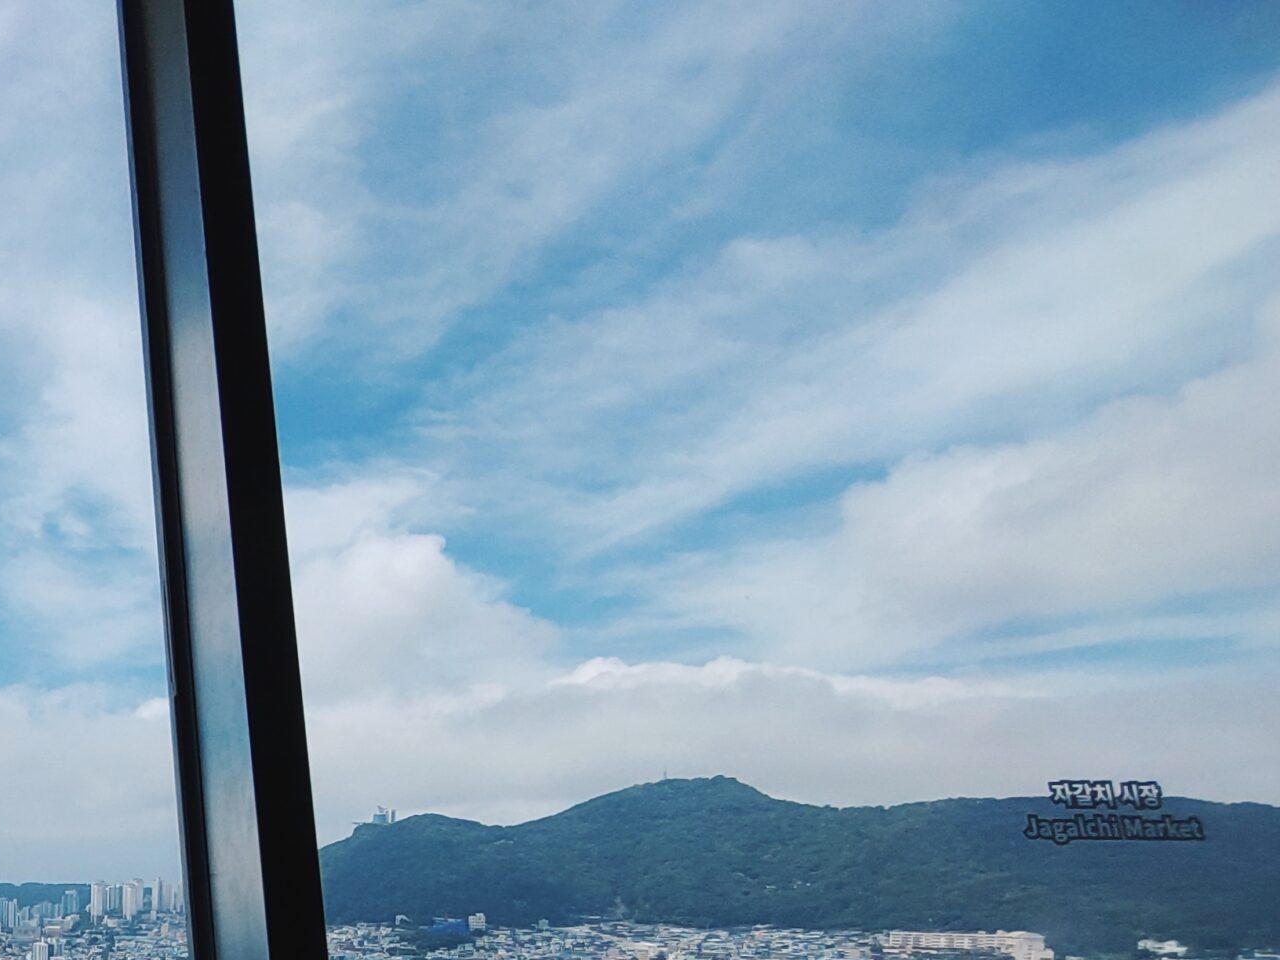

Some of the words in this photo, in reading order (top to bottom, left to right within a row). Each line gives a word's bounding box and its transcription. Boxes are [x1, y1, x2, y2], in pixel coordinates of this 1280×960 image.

[1050, 781, 1117, 808] 자갈치
[1119, 781, 1161, 809] 시장
[1024, 815, 1120, 844] Jagalchi
[1121, 815, 1205, 840] Market
